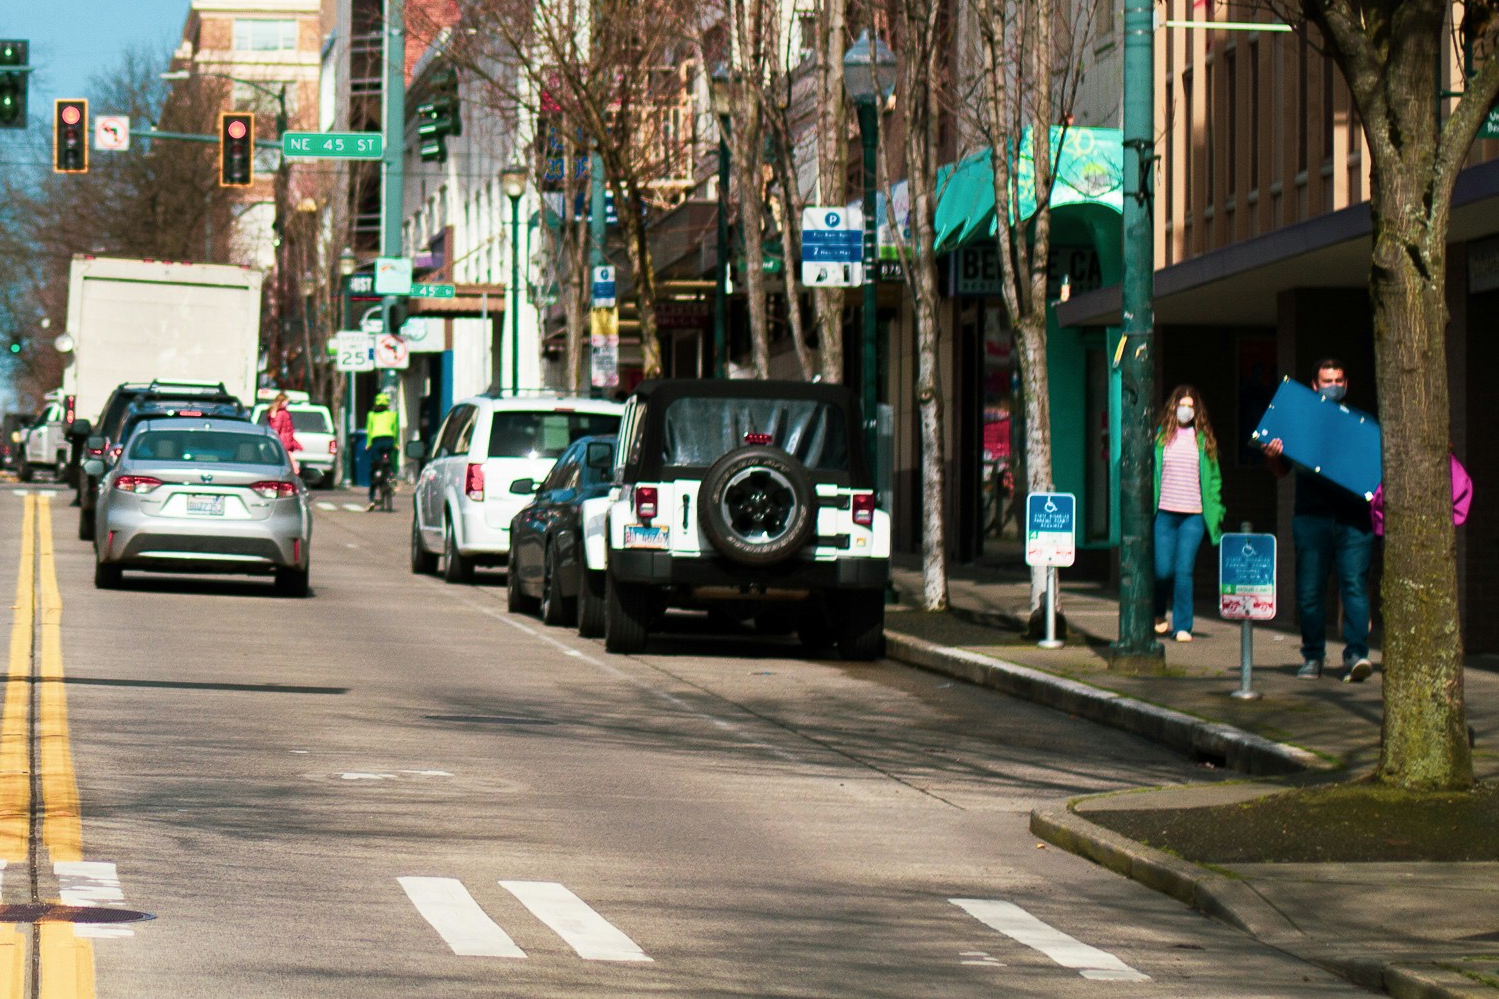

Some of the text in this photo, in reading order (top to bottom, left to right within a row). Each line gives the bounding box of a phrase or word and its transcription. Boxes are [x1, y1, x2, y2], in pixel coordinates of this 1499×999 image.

[290, 138, 375, 152] NE 45 ST
[342, 351, 366, 366] 25
